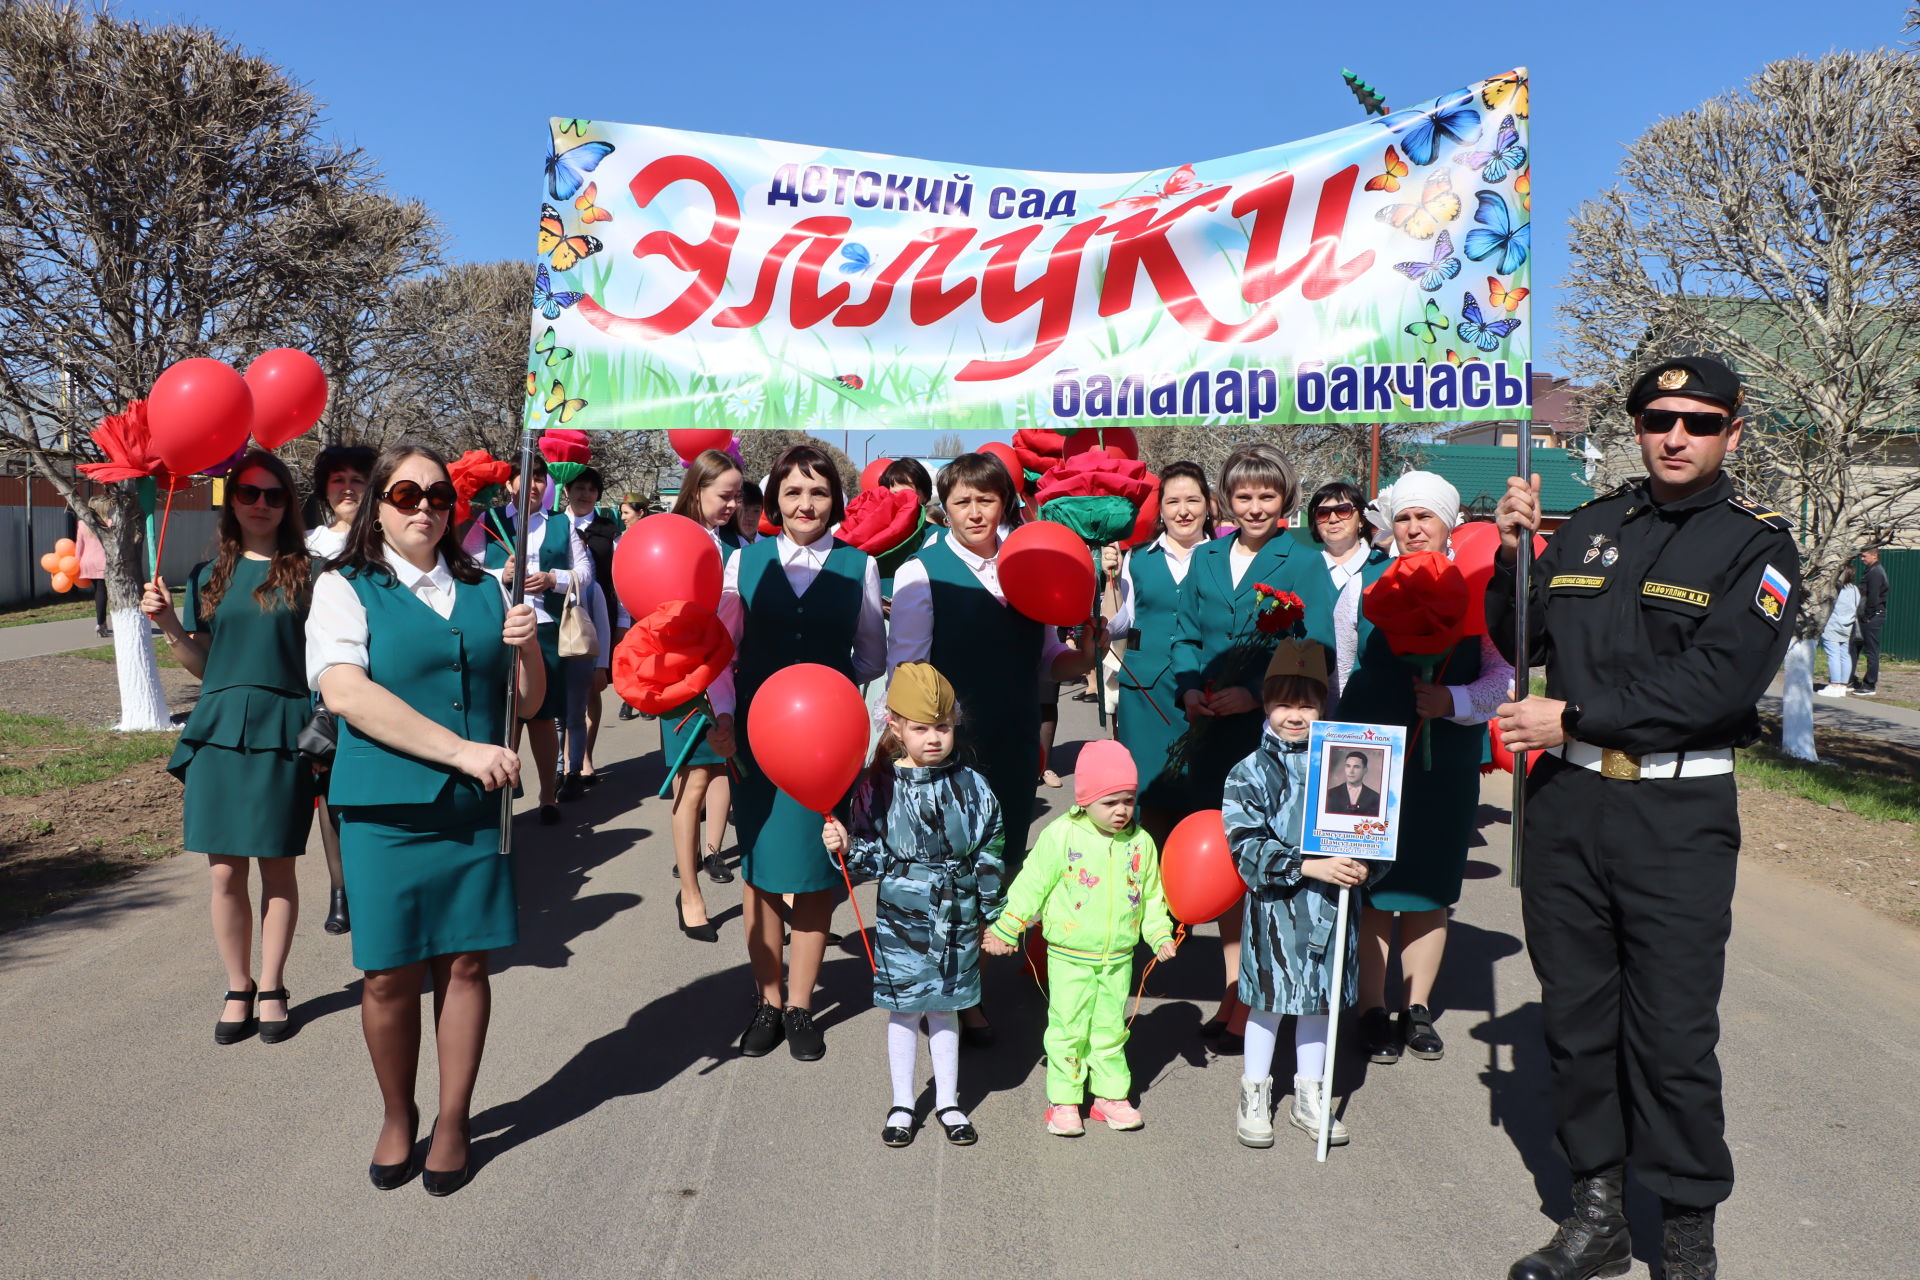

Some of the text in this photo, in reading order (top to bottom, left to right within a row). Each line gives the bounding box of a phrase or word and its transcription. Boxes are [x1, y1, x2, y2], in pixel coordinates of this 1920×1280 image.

[768, 163, 1077, 220] детский сад
[577, 155, 1376, 381] Эллуки
[1052, 361, 1532, 419] балалар бакчасы
[1646, 584, 1705, 604] САЙФУЛЛИН М.М.
